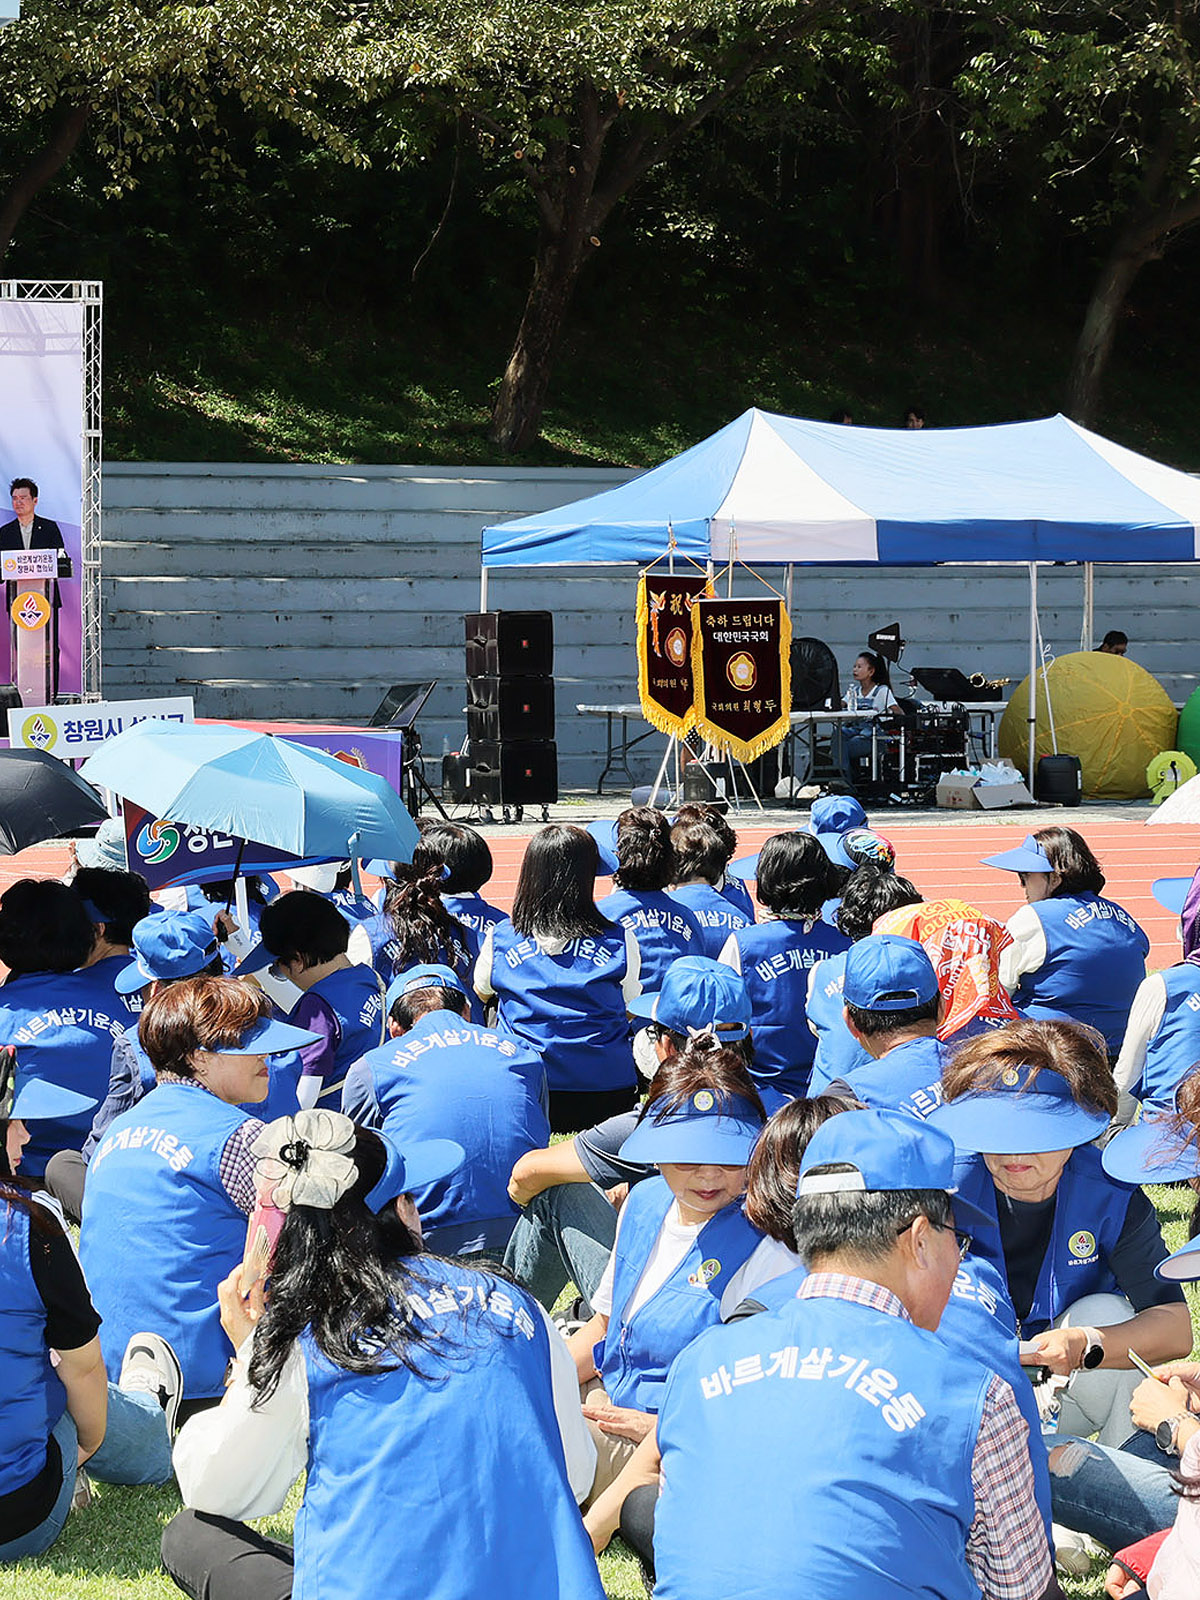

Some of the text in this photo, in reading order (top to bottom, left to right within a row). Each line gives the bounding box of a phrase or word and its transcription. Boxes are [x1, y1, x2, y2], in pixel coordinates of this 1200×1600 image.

[706, 614, 775, 628] 축하 드립니다
[713, 631, 769, 643] 대한민국국회
[64, 717, 124, 743] 창원시
[12, 1007, 125, 1043] 바르게살기운동
[391, 1029, 518, 1068] 바르게살기운동
[700, 1346, 927, 1433] 바르게살기운동
